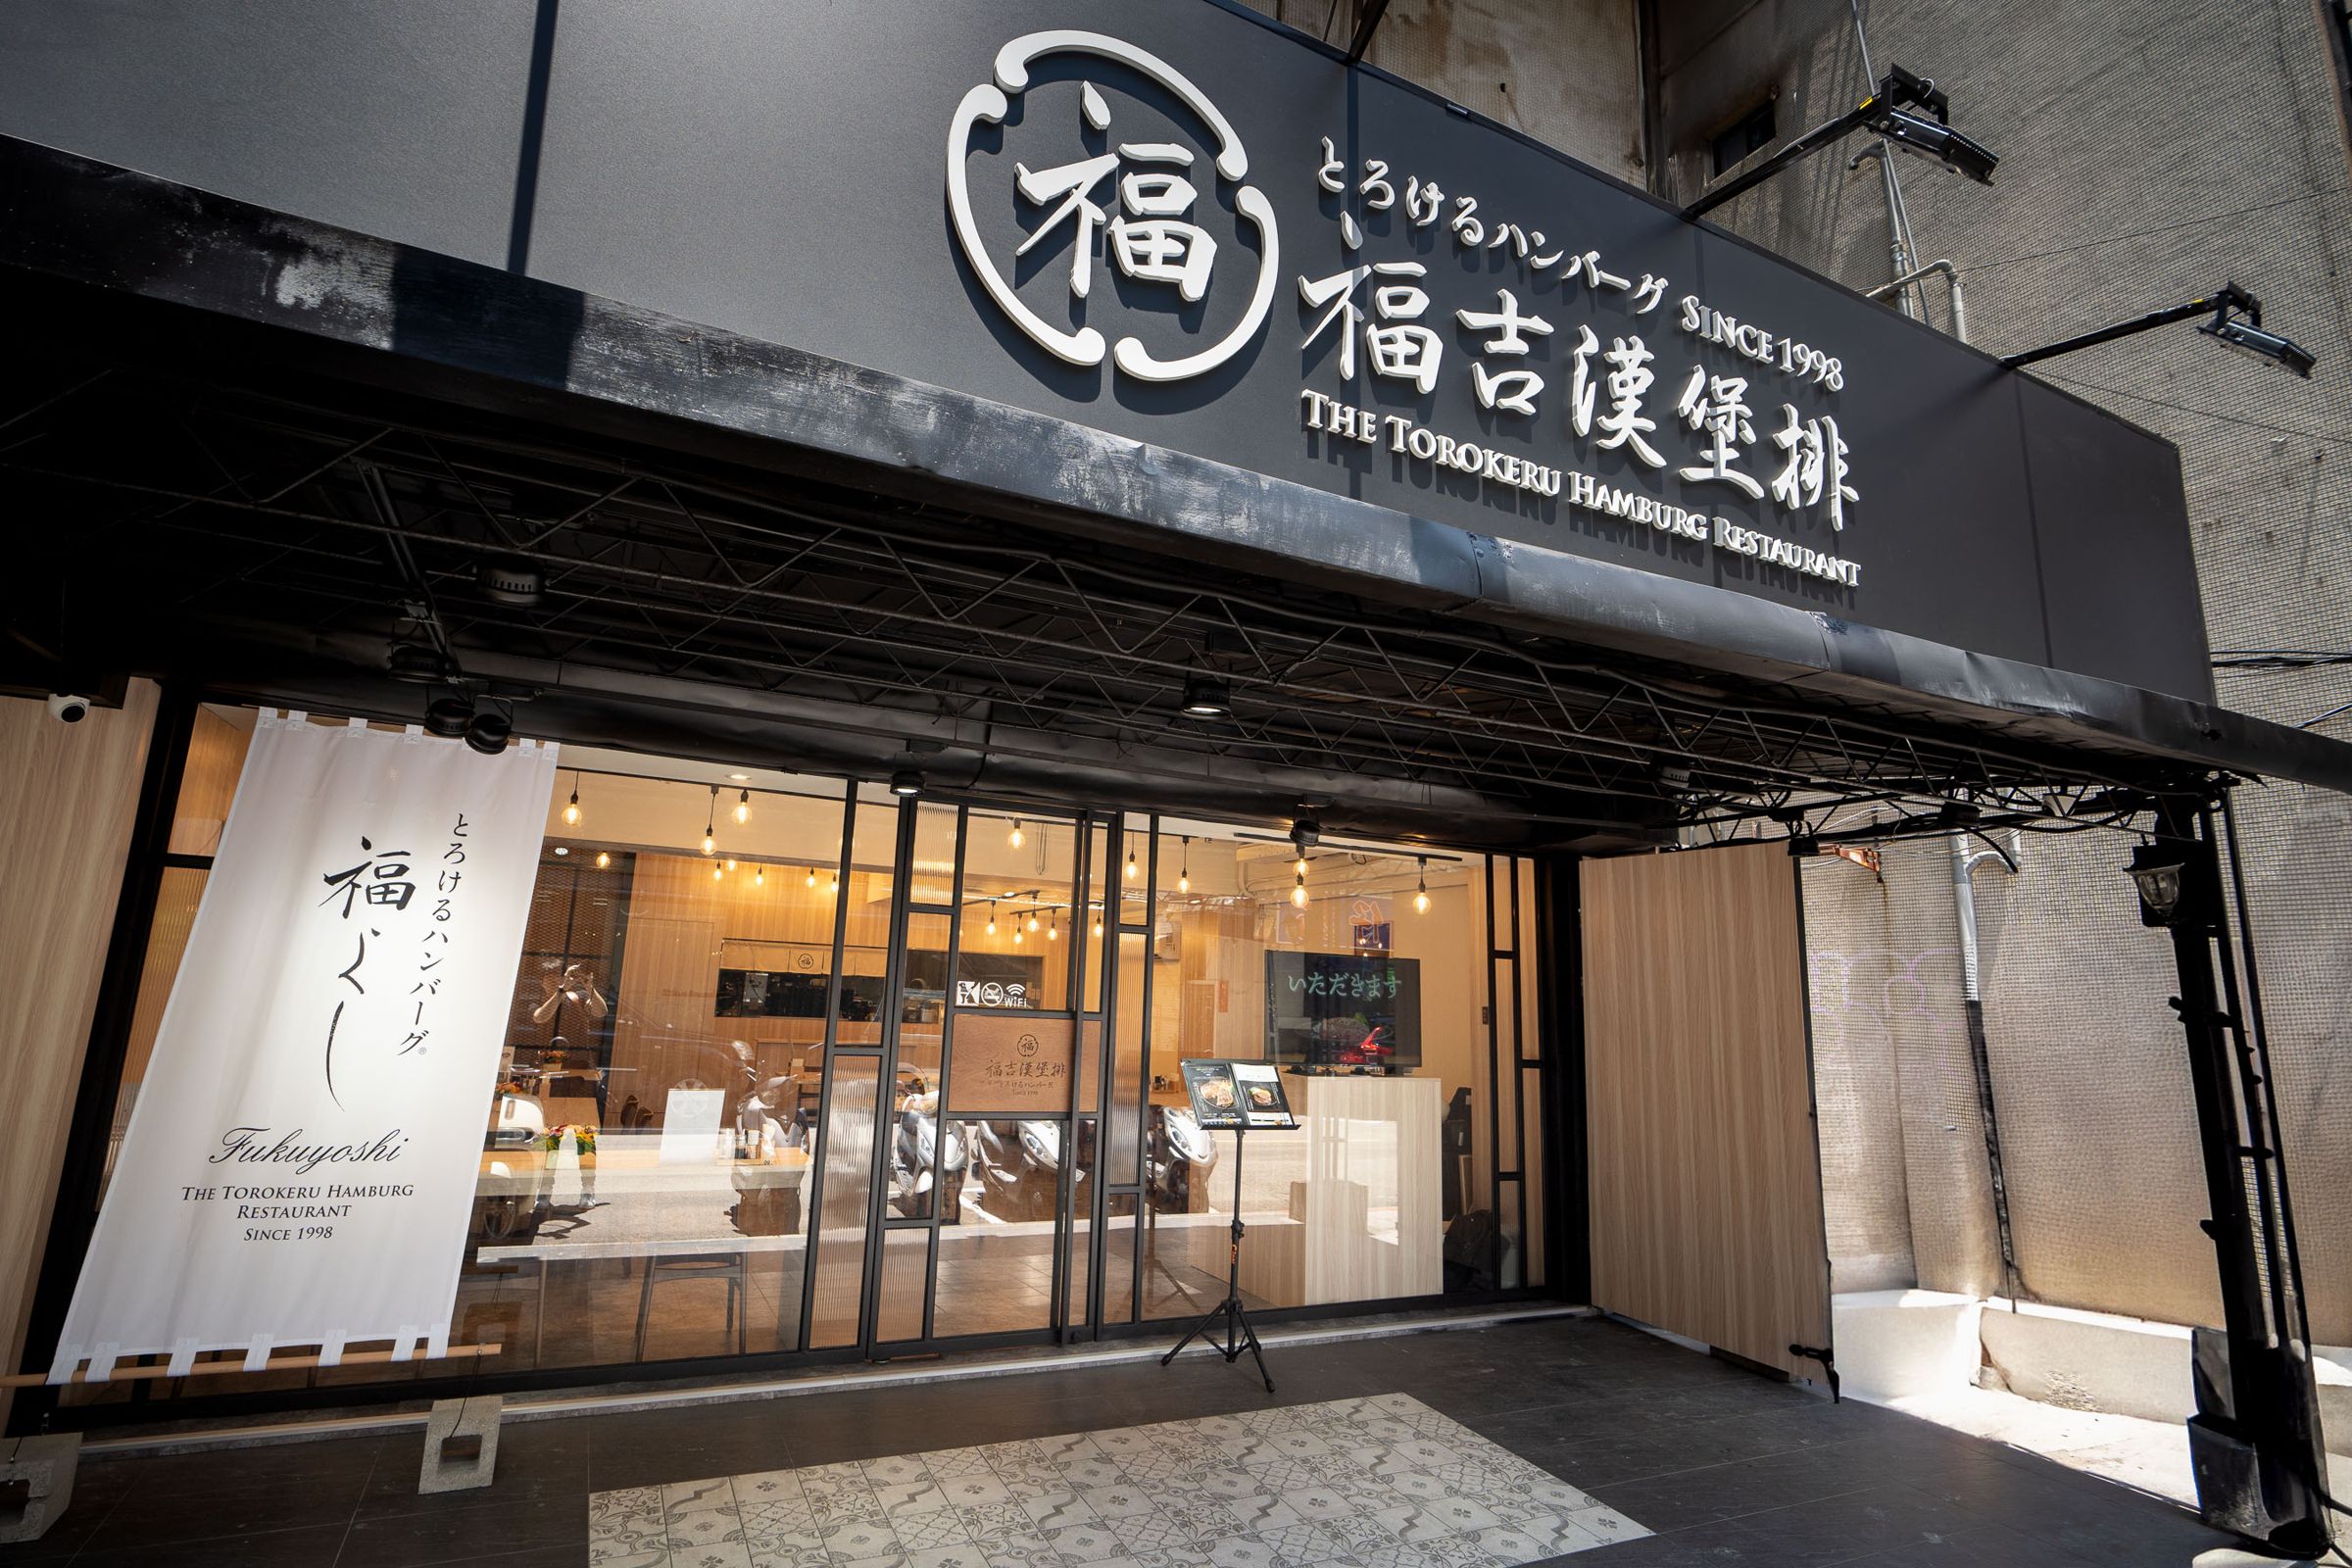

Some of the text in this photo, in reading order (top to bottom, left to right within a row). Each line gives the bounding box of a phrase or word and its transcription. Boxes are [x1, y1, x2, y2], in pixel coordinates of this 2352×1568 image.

[1015, 80, 1217, 302] 福
[1318, 136, 1668, 315] とろけるハンバーグ
[1298, 210, 1860, 531] 福吉漢堡排
[1682, 295, 1844, 392] SINCE 1998
[1301, 389, 1861, 586] THE TOROKERU HAMBURG RESTAURANT
[398, 812, 468, 1055] とろけるハンバーグ
[1288, 972, 1402, 998] いただきます
[985, 1059, 1066, 1078] 福吉漢堡排
[209, 1127, 409, 1175] Fukuyoshi
[182, 1184, 414, 1200] THE TOROKERU HAMBURG
[236, 1204, 352, 1219] RESTAURANT
[243, 1226, 333, 1241] SINCE 1998
